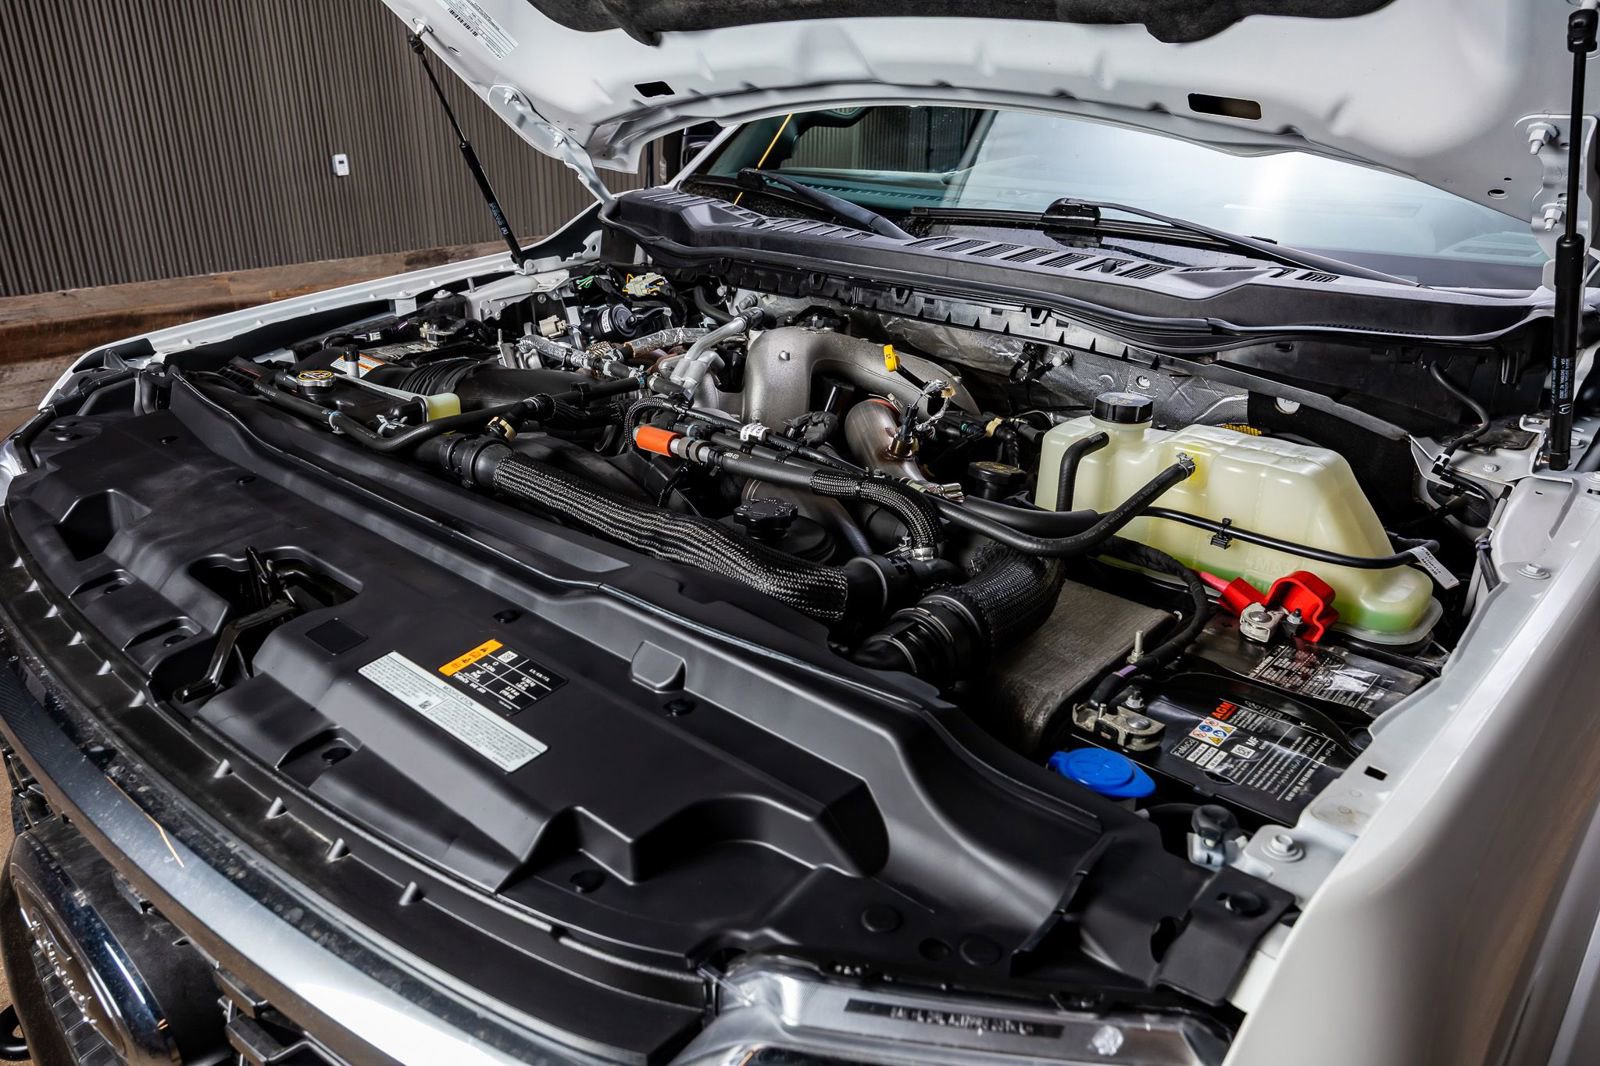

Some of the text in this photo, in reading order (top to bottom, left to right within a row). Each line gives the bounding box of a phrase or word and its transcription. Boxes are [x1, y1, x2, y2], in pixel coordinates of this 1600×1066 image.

[443, 686, 473, 706] MODIFICATION
[1211, 701, 1234, 719] AGM
[1174, 738, 1197, 757] FoMoCo
[1246, 736, 1259, 747] MF
